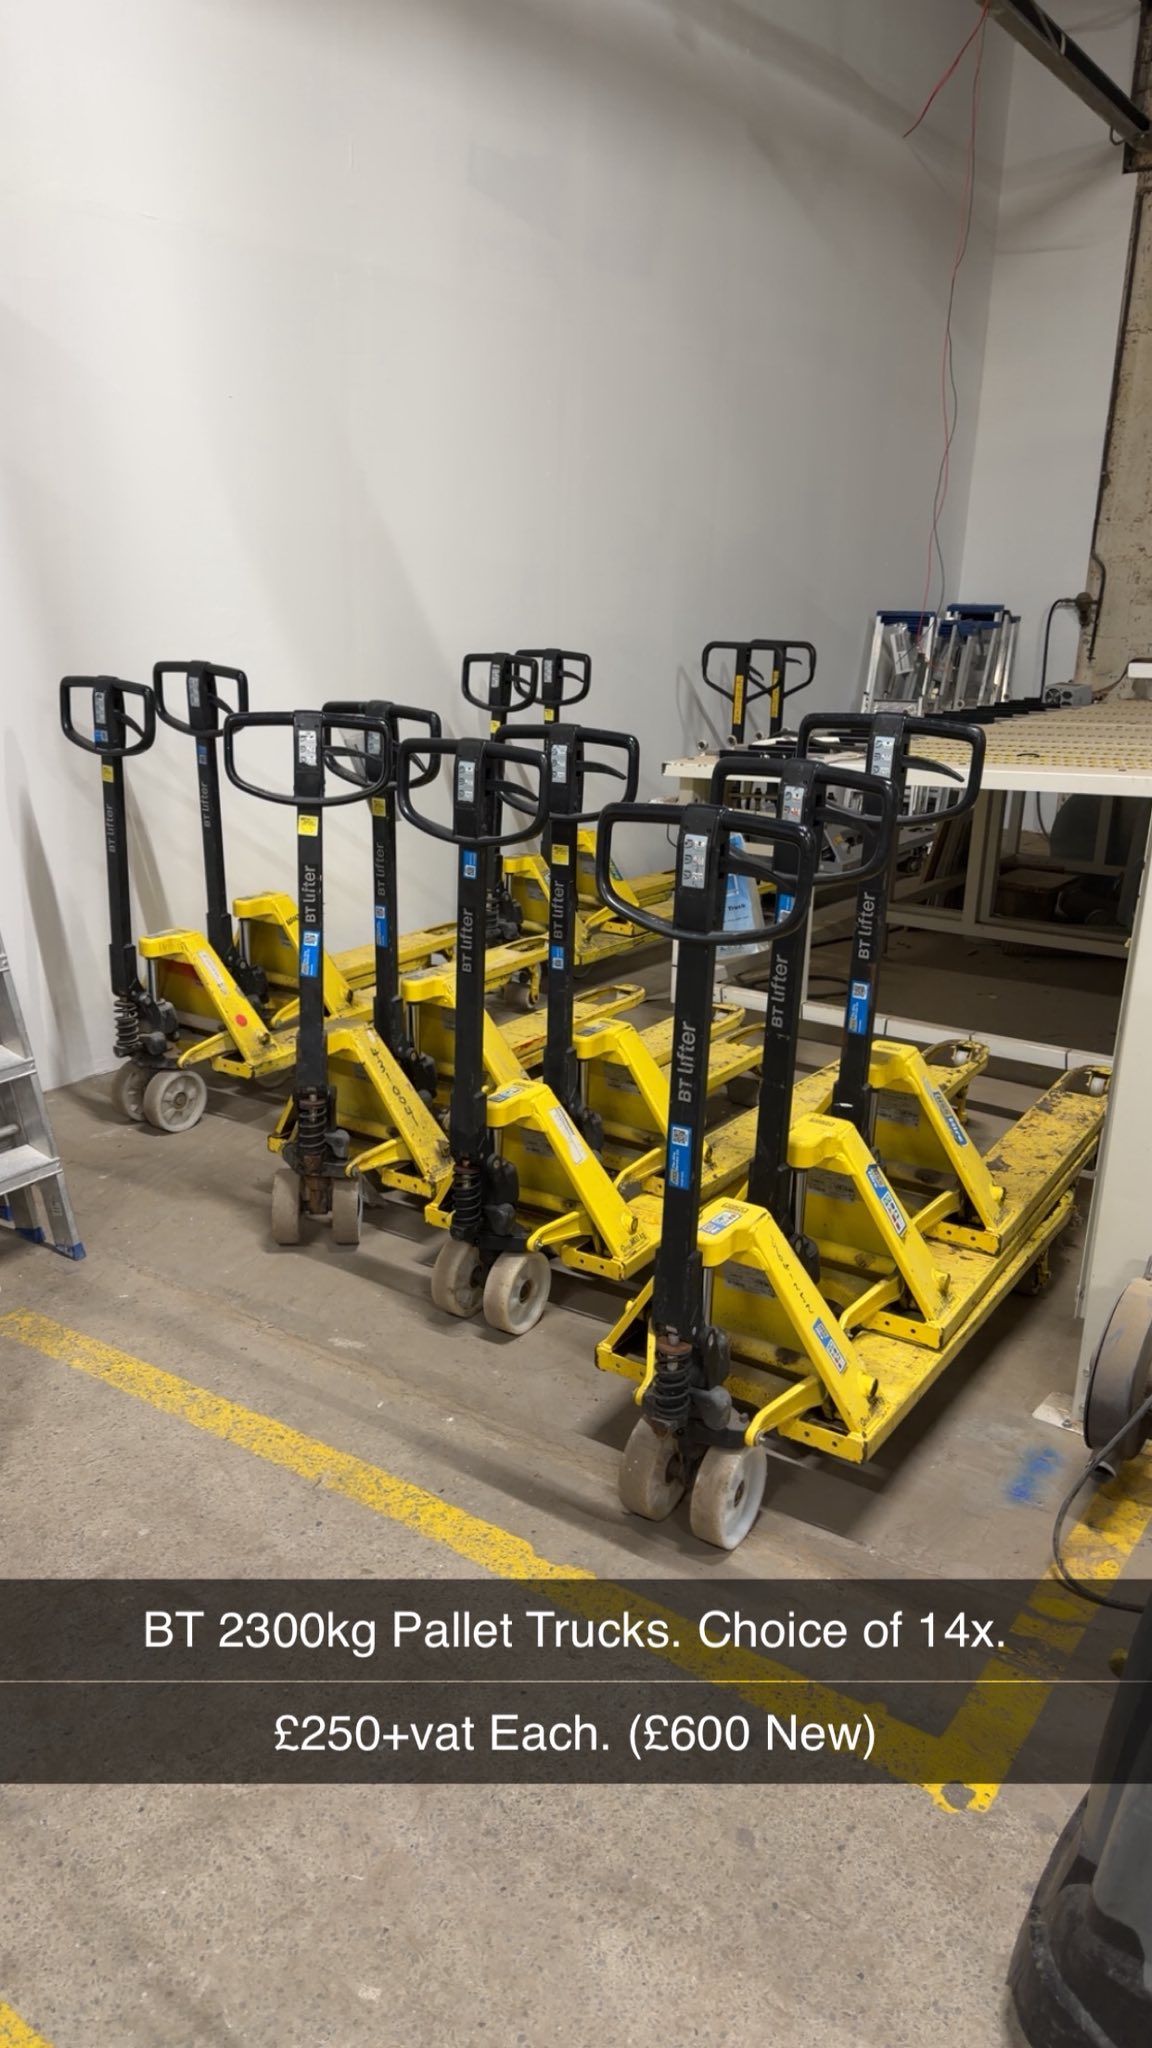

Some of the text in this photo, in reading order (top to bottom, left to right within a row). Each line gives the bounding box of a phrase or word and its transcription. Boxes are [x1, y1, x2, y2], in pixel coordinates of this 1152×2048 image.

[301, 865, 317, 923] BT lifter
[375, 841, 386, 897] BT lifter
[552, 880, 565, 919] lifter
[460, 908, 474, 973] BT lifter
[553, 921, 564, 939] BT
[857, 891, 876, 960] BT lifter
[770, 954, 789, 1028] BT lifter
[676, 1021, 697, 1103] BT lifter
